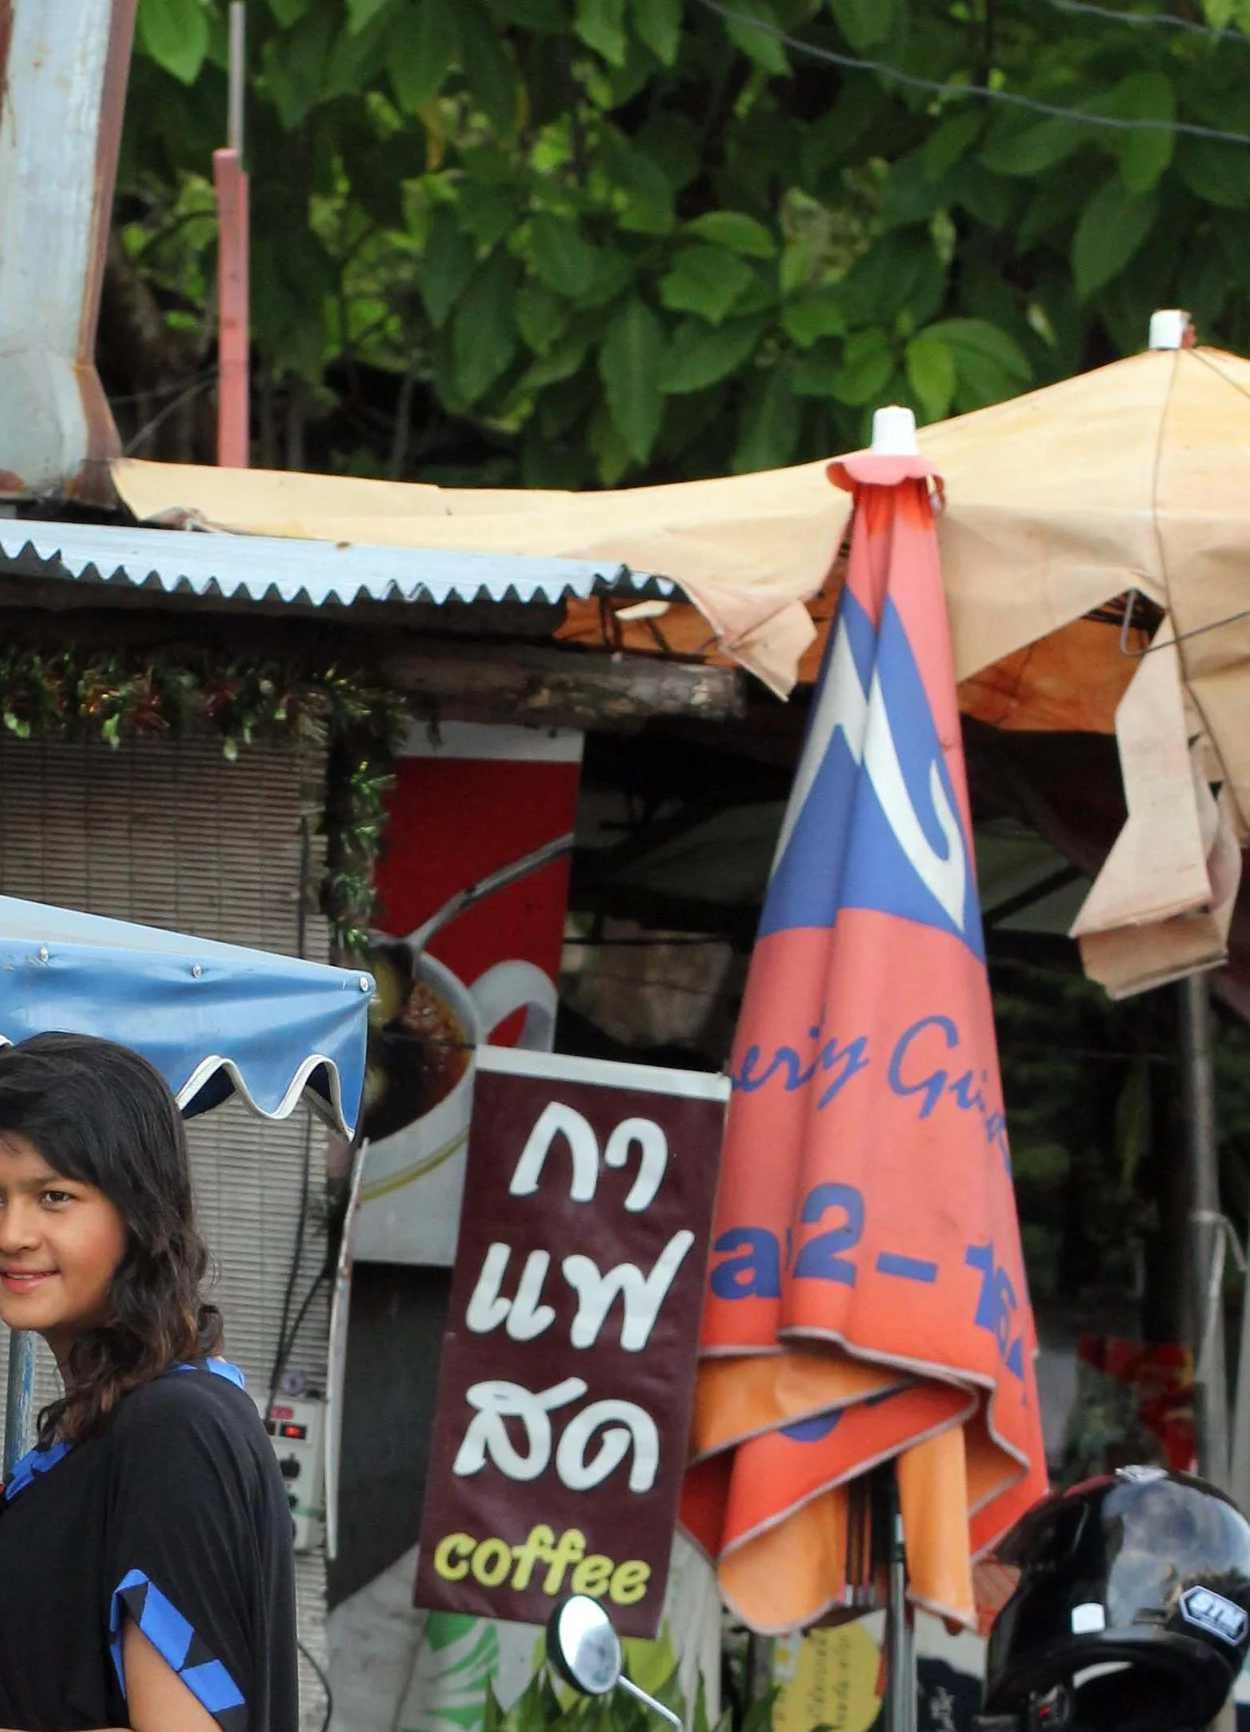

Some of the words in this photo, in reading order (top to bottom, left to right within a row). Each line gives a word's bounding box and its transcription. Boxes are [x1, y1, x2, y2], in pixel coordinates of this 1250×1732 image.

[508, 1101, 668, 1213] กา
[465, 1229, 695, 1352] แฟ
[452, 1376, 659, 1494] สด
[433, 1523, 651, 1605] coffee
